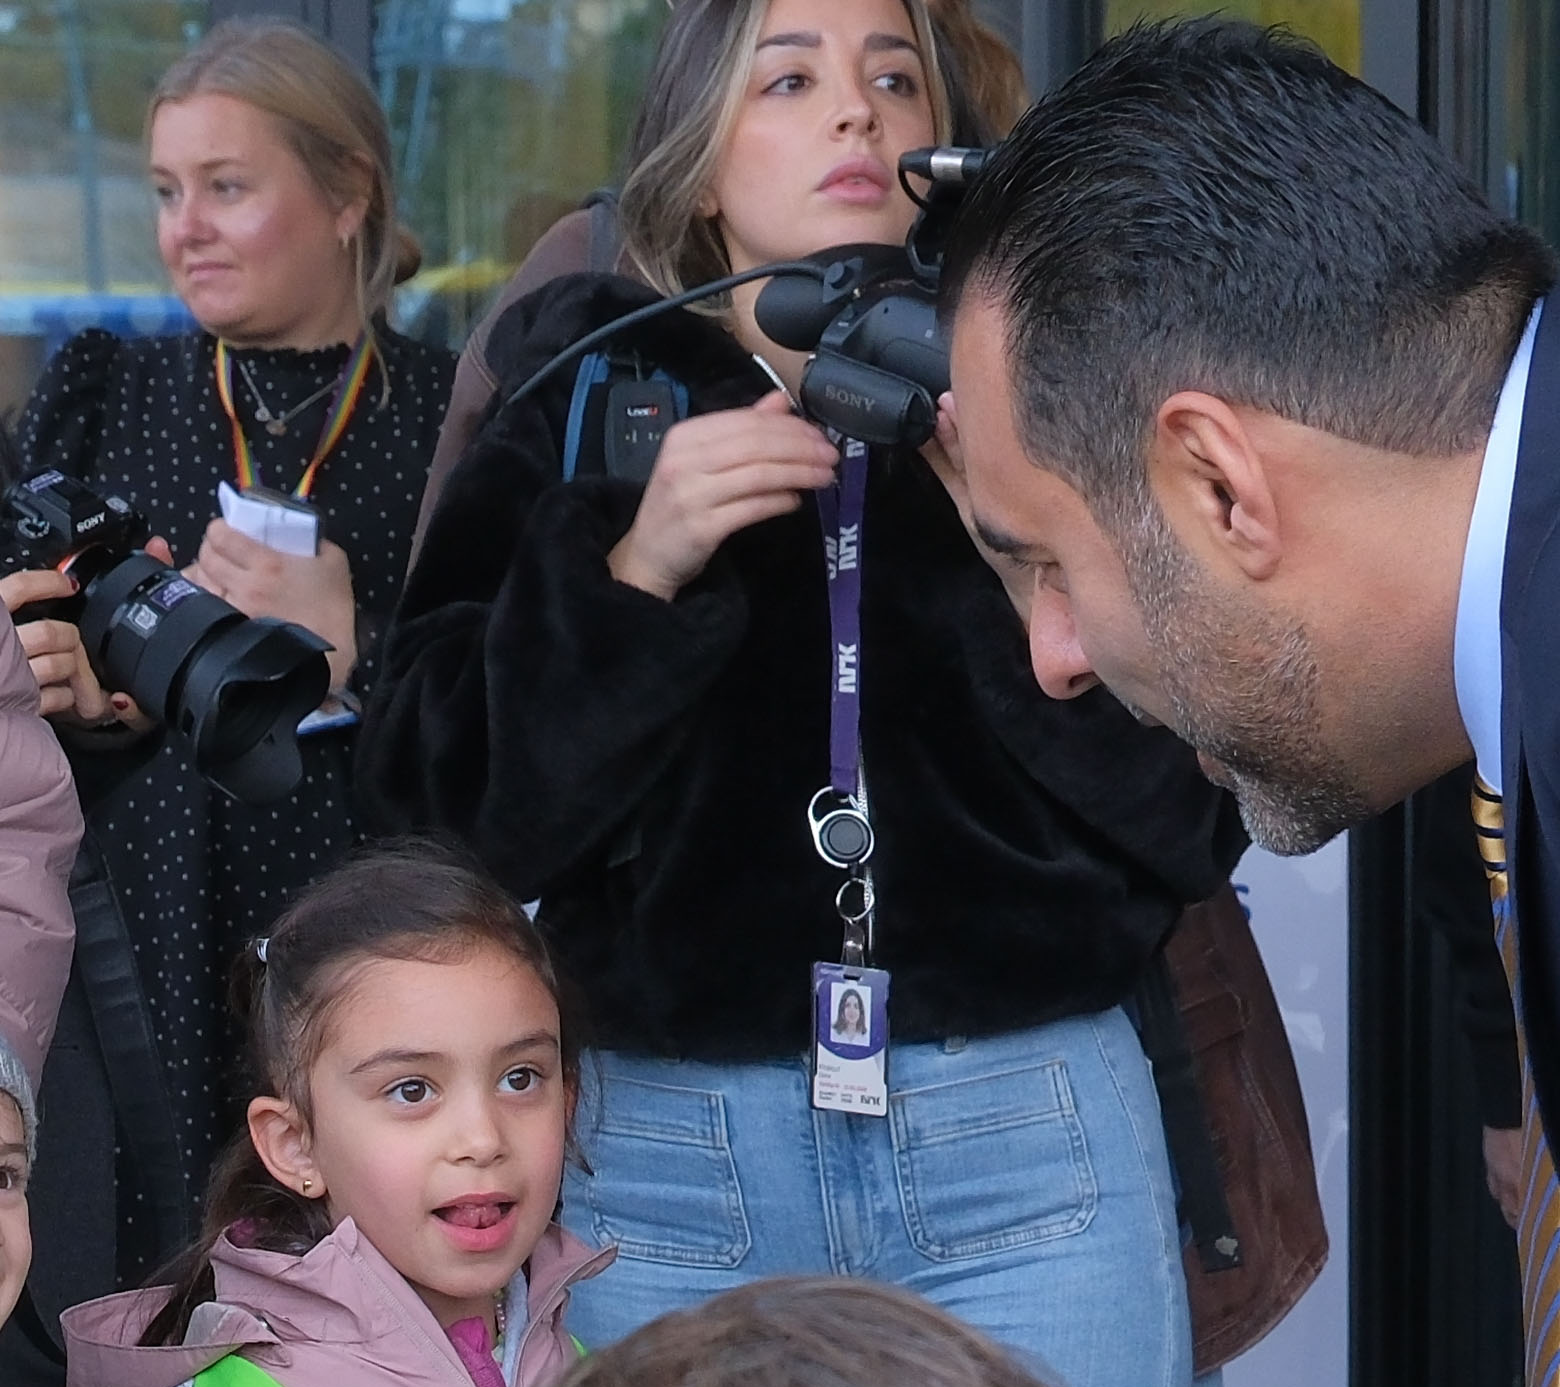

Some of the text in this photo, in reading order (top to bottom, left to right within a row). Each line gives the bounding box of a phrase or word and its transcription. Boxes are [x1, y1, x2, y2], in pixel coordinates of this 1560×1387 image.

[825, 384, 876, 413] SONY
[76, 511, 106, 533] SONY
[838, 643, 858, 693] NRK
